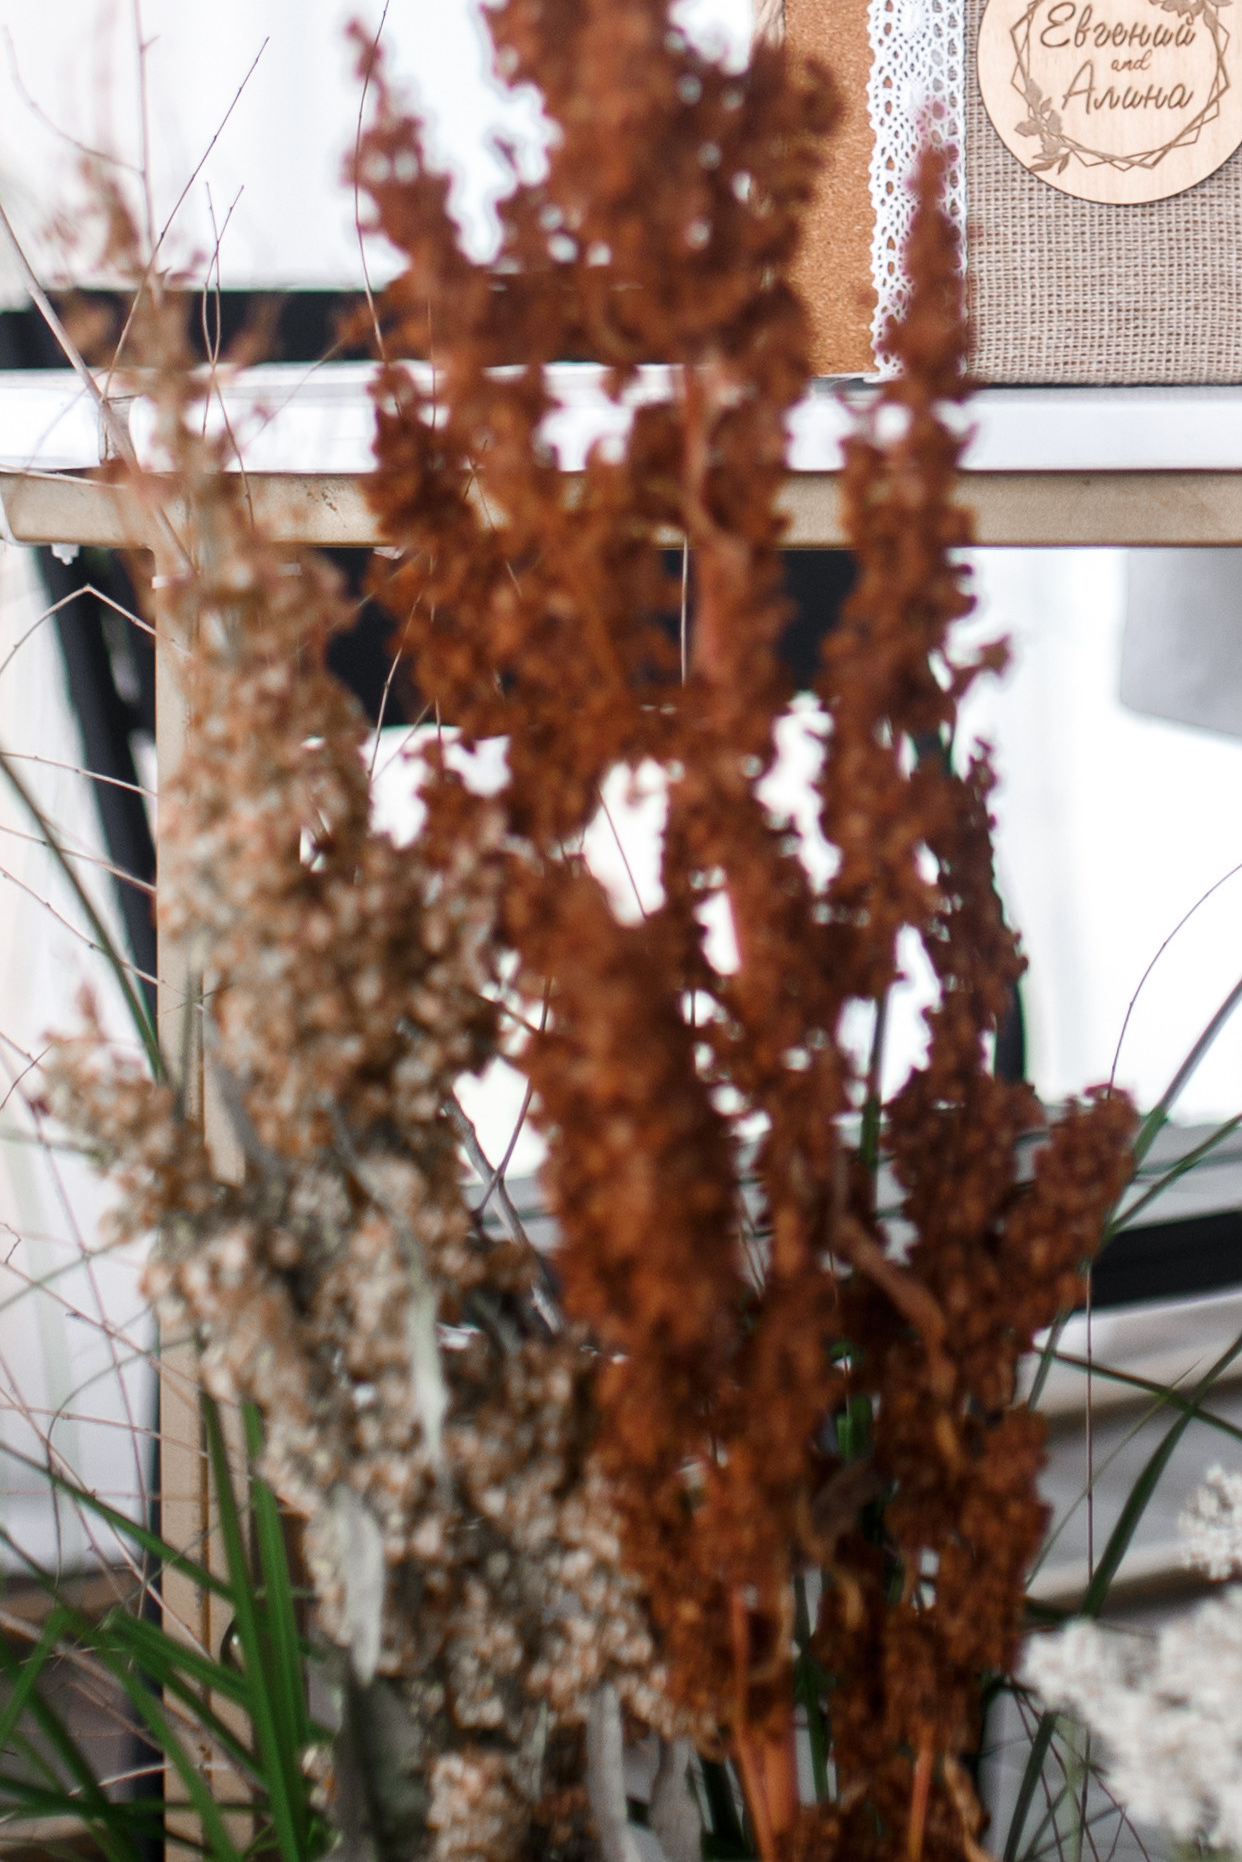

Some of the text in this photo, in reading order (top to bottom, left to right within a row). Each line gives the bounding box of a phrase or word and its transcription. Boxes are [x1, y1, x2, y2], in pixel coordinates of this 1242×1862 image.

[1039, 1, 1197, 49] Евгений
[1110, 49, 1153, 72] and
[1061, 59, 1195, 115] Алина
